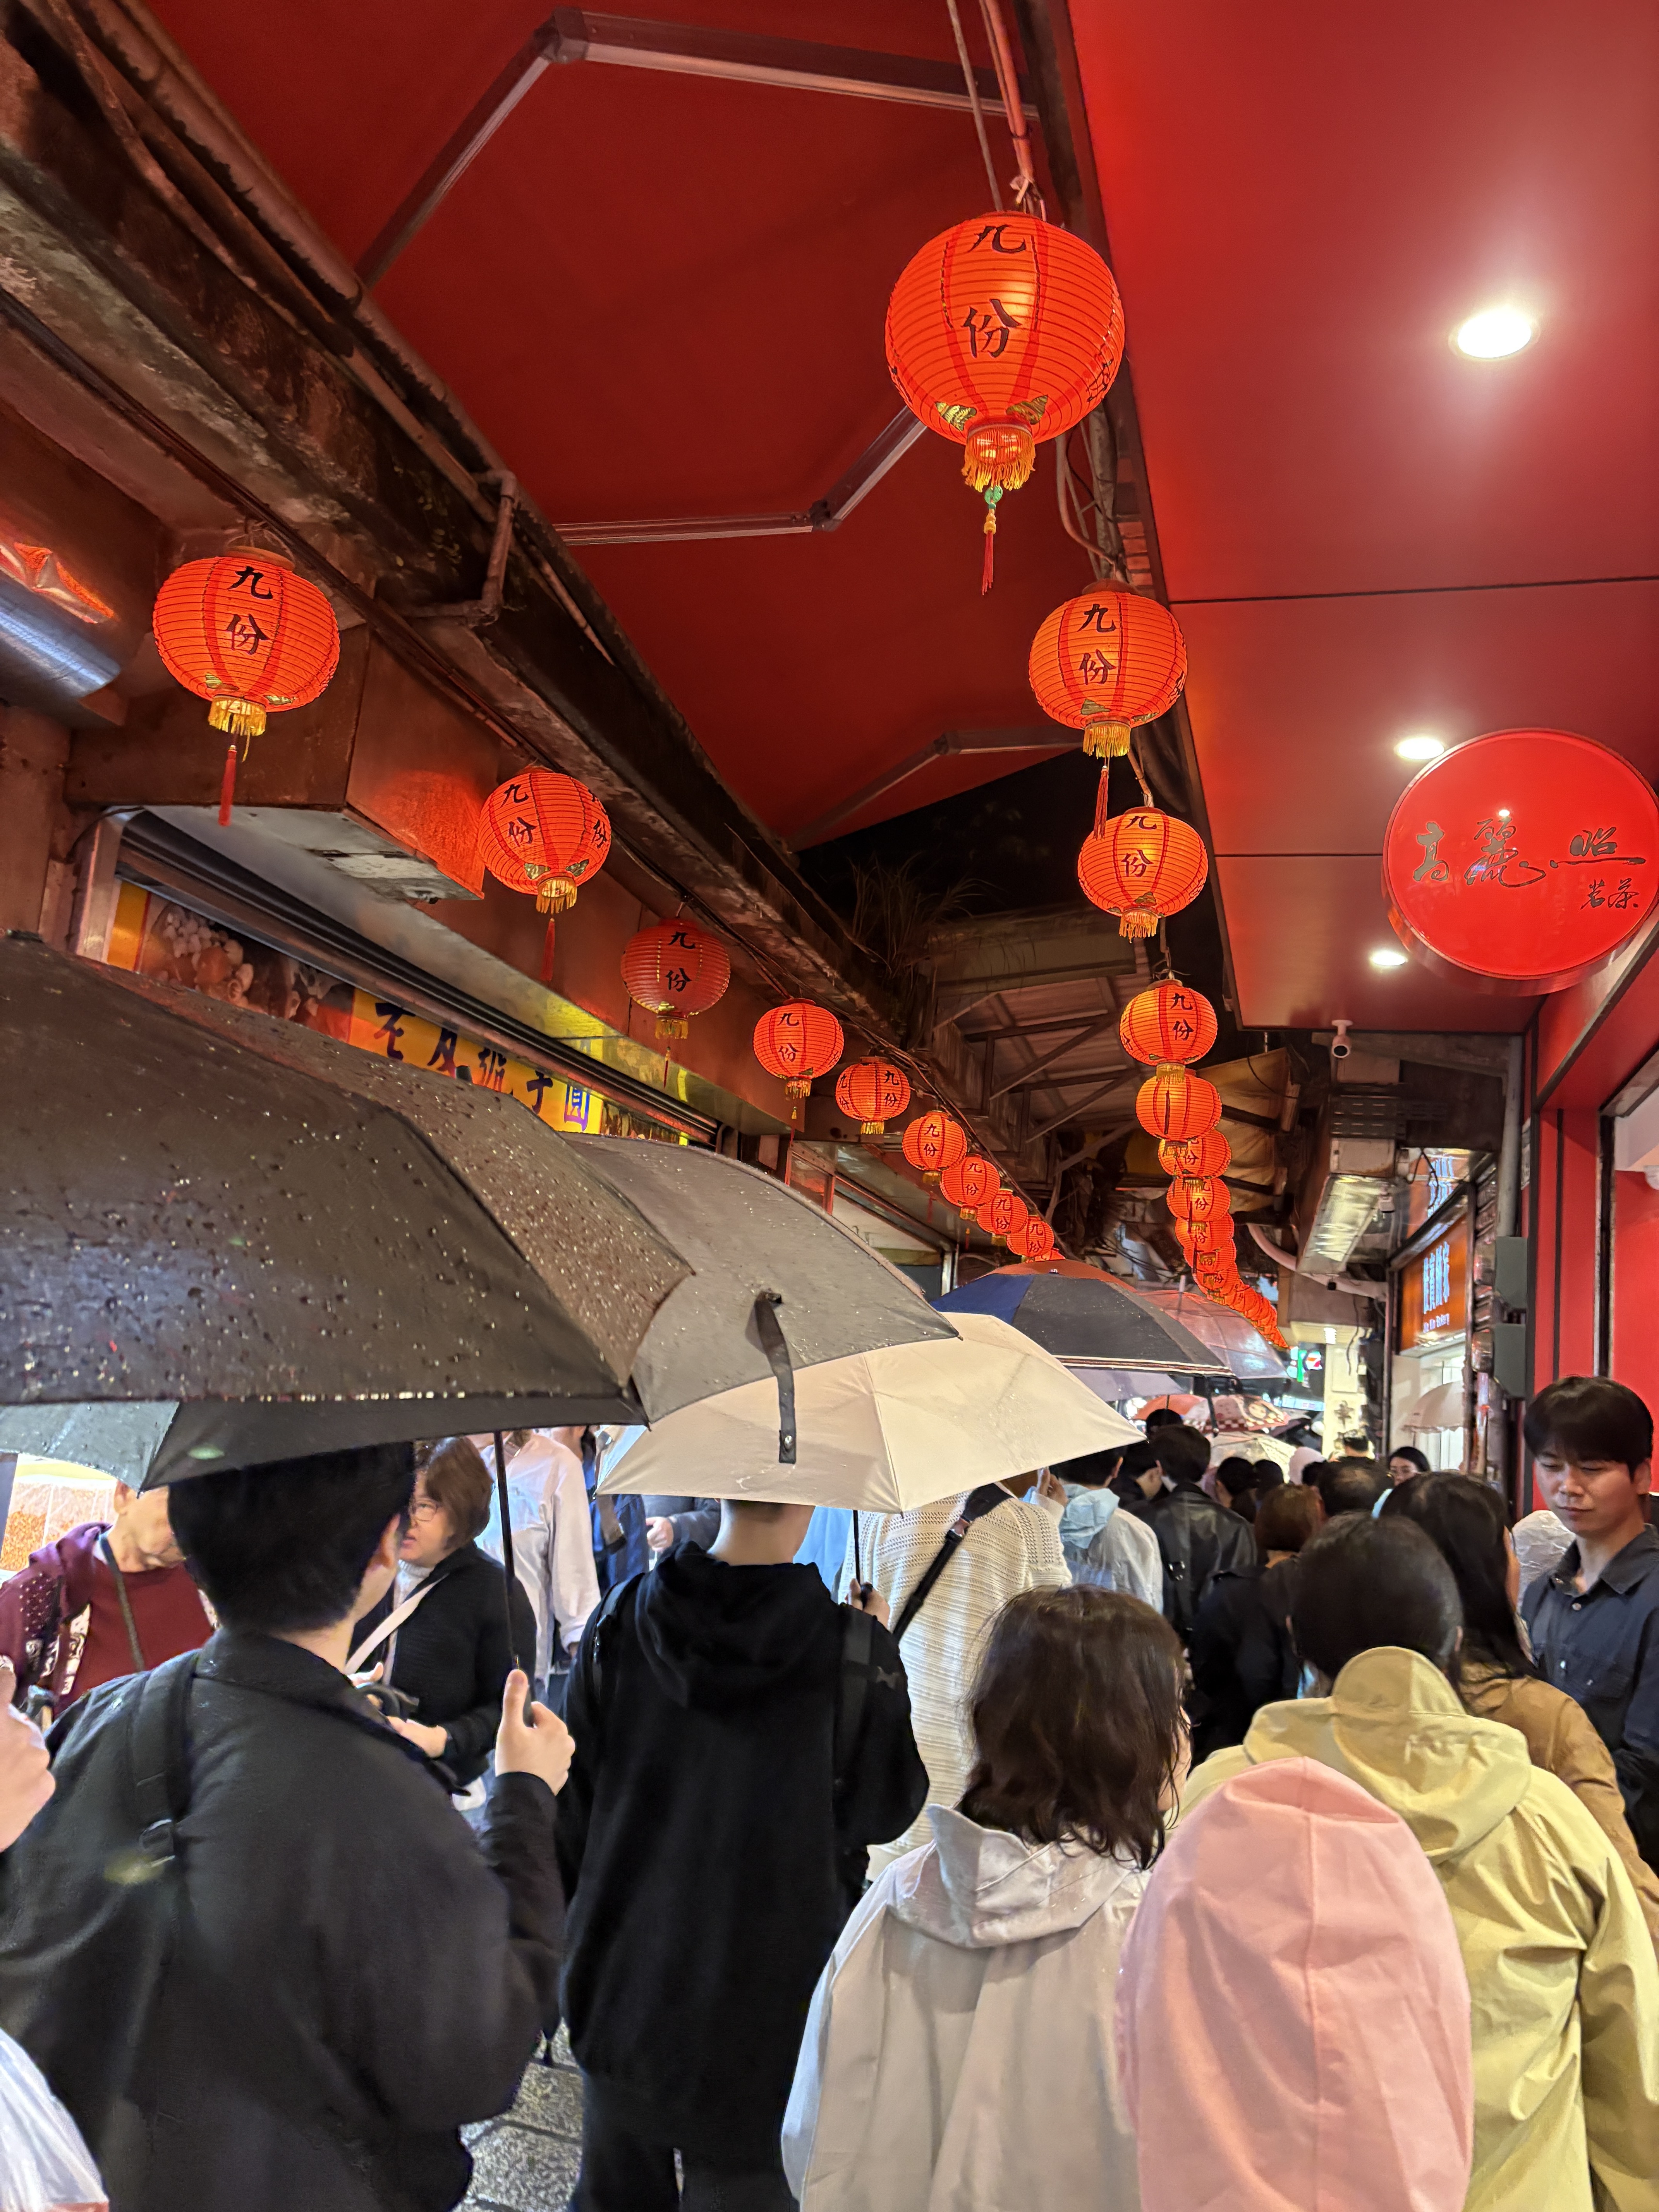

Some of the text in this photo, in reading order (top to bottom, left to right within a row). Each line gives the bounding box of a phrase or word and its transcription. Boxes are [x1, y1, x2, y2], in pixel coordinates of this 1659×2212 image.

[961, 224, 1026, 358] 九份
[227, 565, 273, 655] 九份
[1077, 603, 1116, 685] 九份
[500, 784, 536, 847] 九份
[1121, 816, 1157, 878] 九份
[666, 931, 696, 992] 九份
[777, 1013, 800, 1062] 九份
[1170, 993, 1194, 1041] 九份
[884, 1070, 900, 1107] 九份
[924, 1124, 940, 1157] 九份
[965, 1163, 982, 1196] 九份
[996, 1198, 1012, 1230] 九份
[1029, 1223, 1044, 1253] 九份
